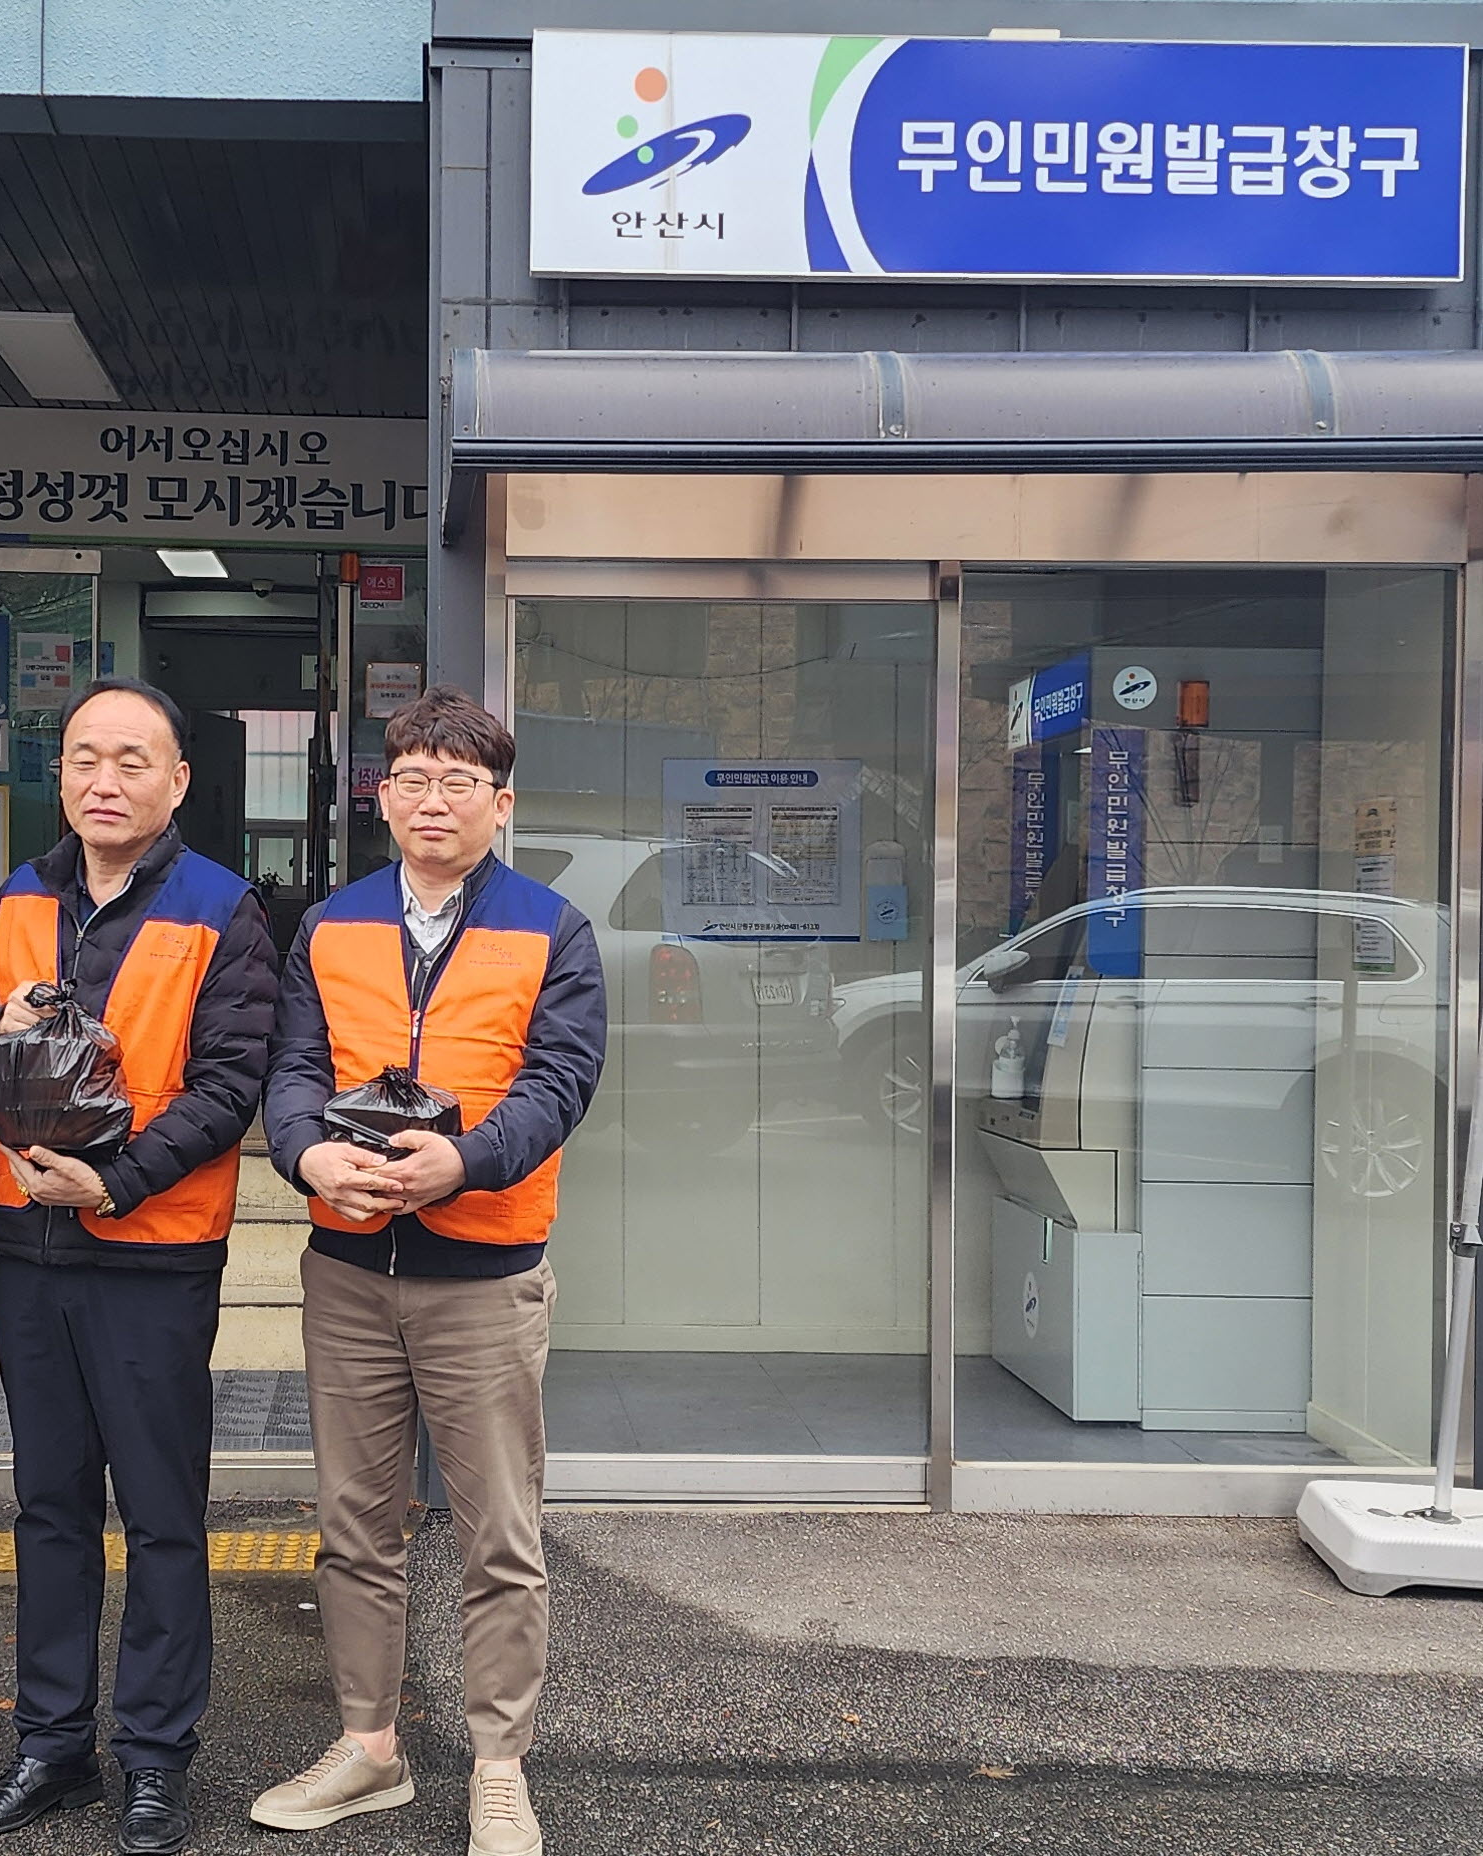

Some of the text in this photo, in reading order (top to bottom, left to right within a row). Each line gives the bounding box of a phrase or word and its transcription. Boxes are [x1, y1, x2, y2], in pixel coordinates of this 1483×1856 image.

[897, 120, 1420, 199] 무인민원발급창구
[611, 211, 725, 240] 안산시
[99, 424, 331, 467] 어서오십시오
[359, 601, 385, 609] SECOM
[1033, 681, 1084, 724] 무인민원발급창구
[716, 772, 809, 784] 무인민원발급 이용 안내
[1104, 750, 1130, 928] 무인민원발급창구
